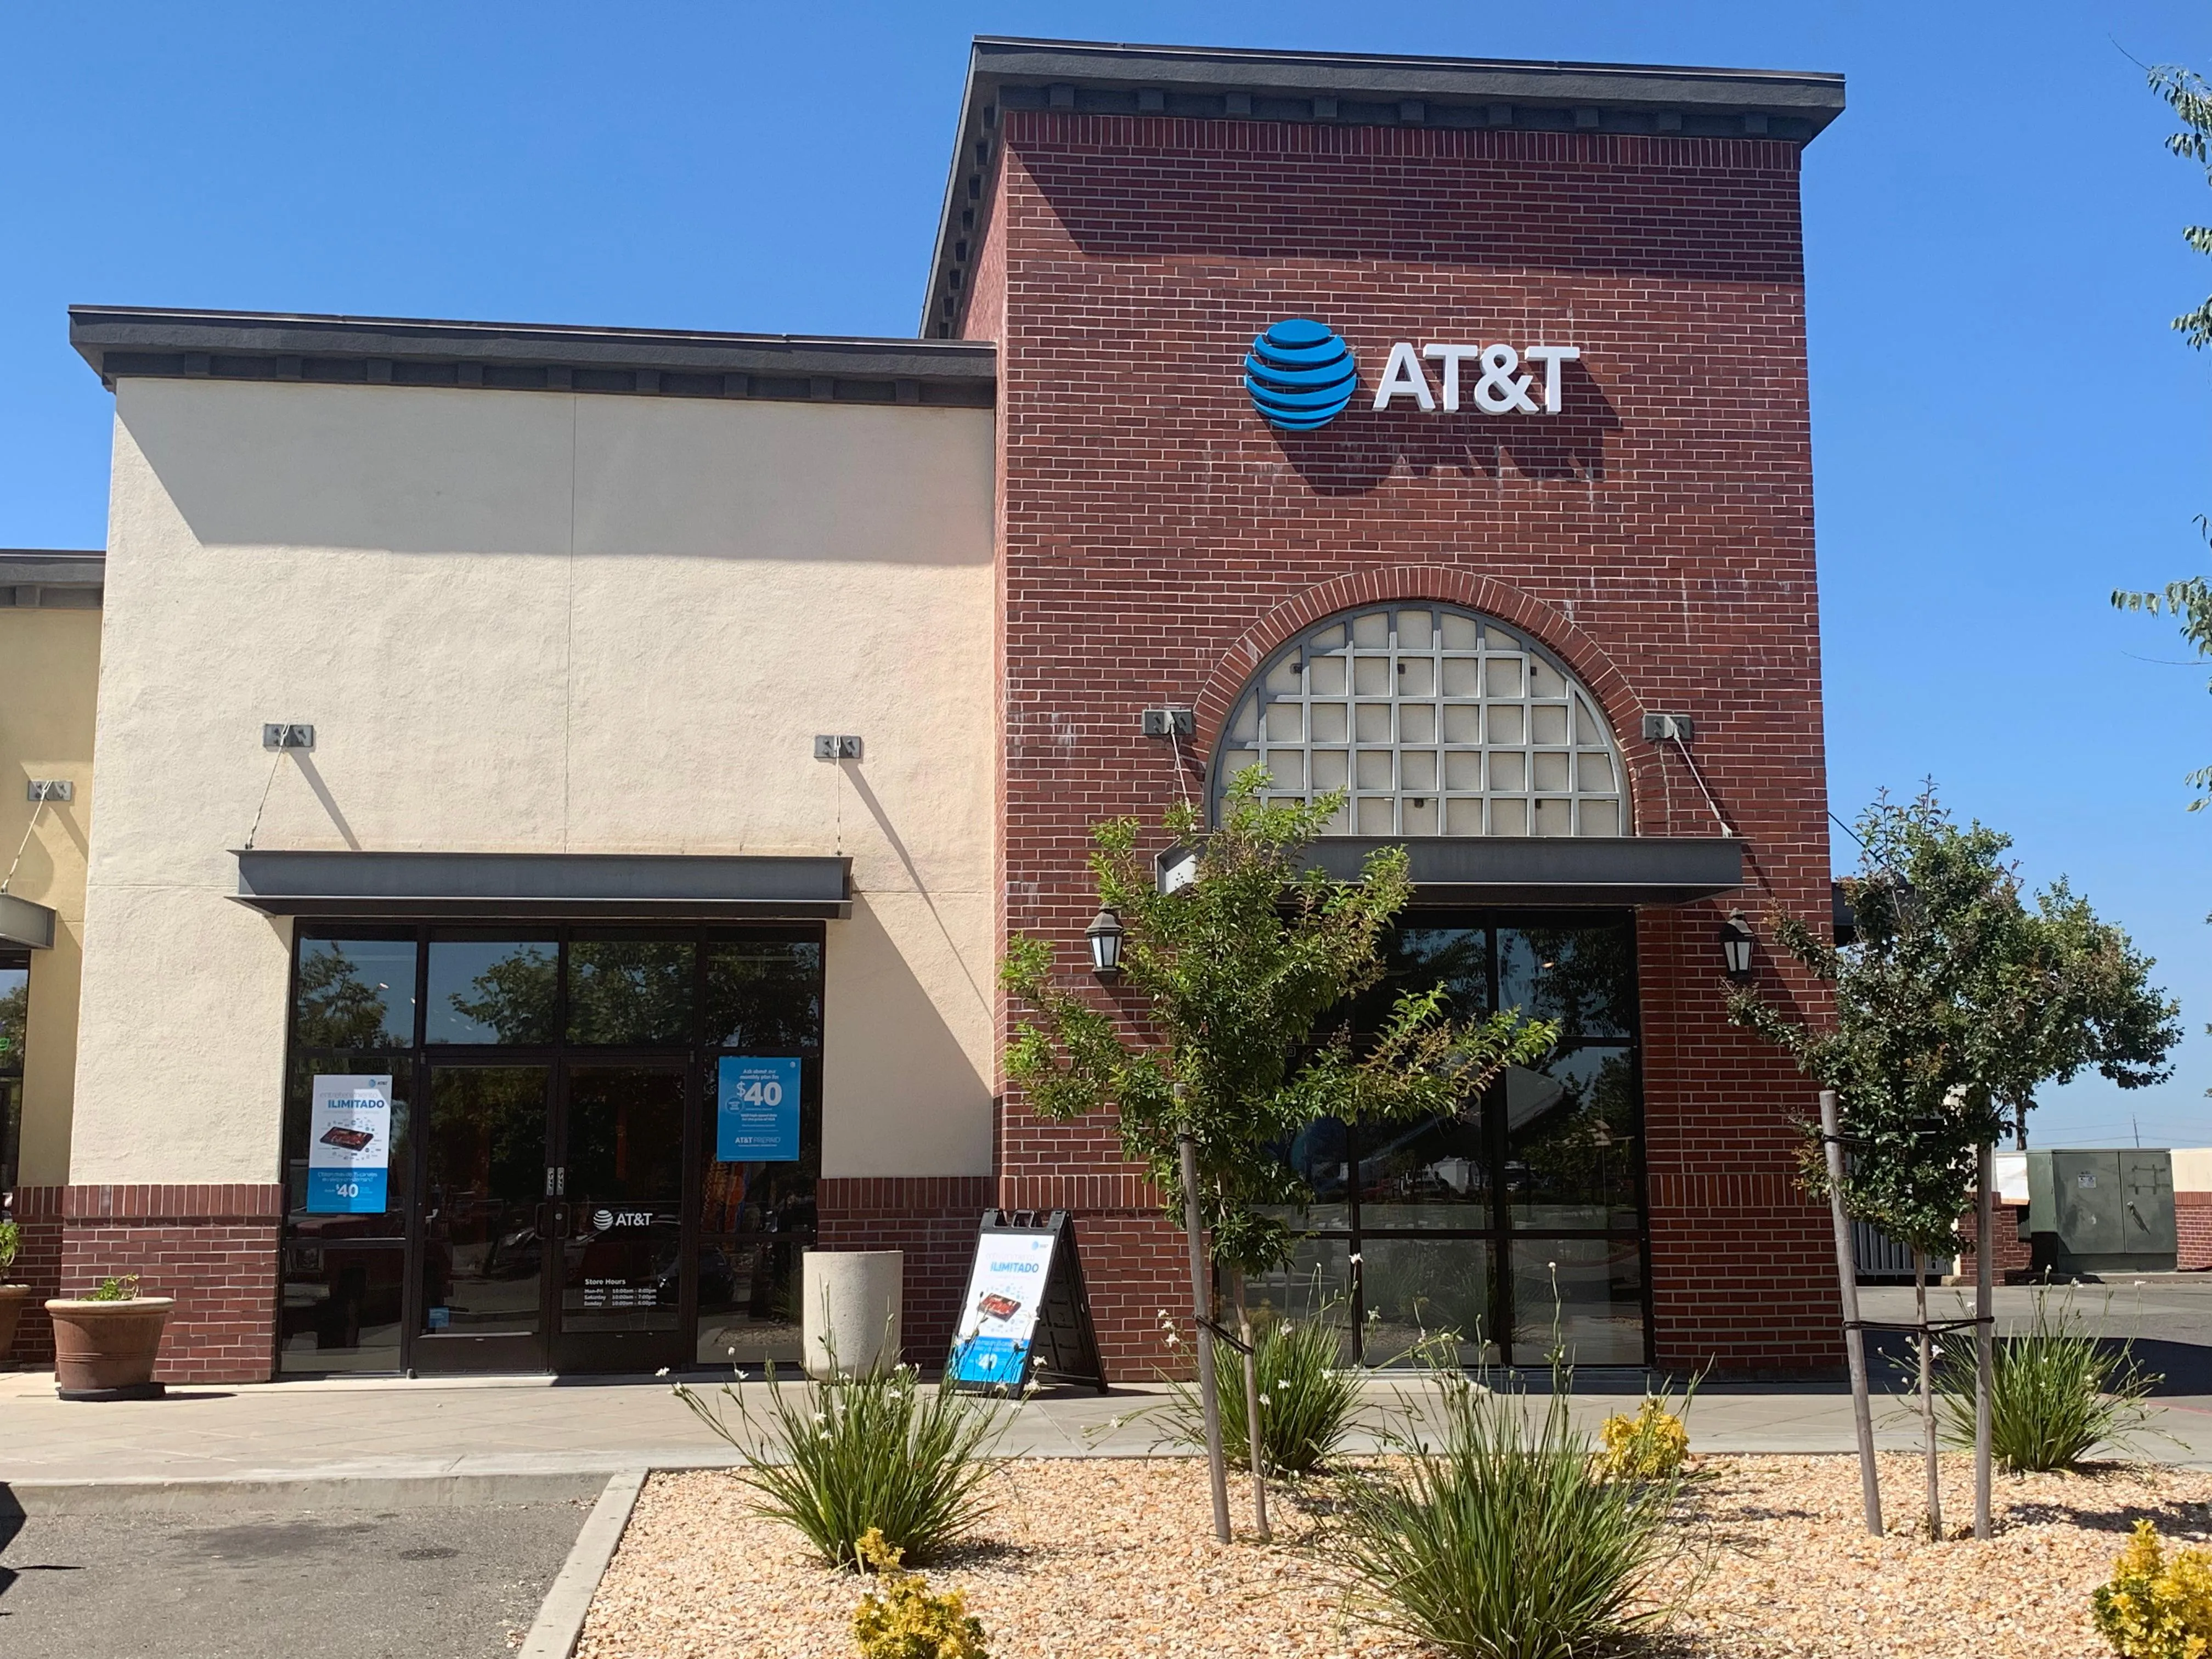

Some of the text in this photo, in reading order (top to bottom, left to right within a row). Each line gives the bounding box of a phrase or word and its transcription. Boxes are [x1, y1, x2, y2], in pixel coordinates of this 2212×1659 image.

[1372, 342, 1580, 415] AT&T
[736, 1081, 782, 1106] $40
[328, 1099, 385, 1108] ILIMITADO
[616, 1213, 653, 1226] AT&T
[990, 1262, 1039, 1273] ILIMITADO
